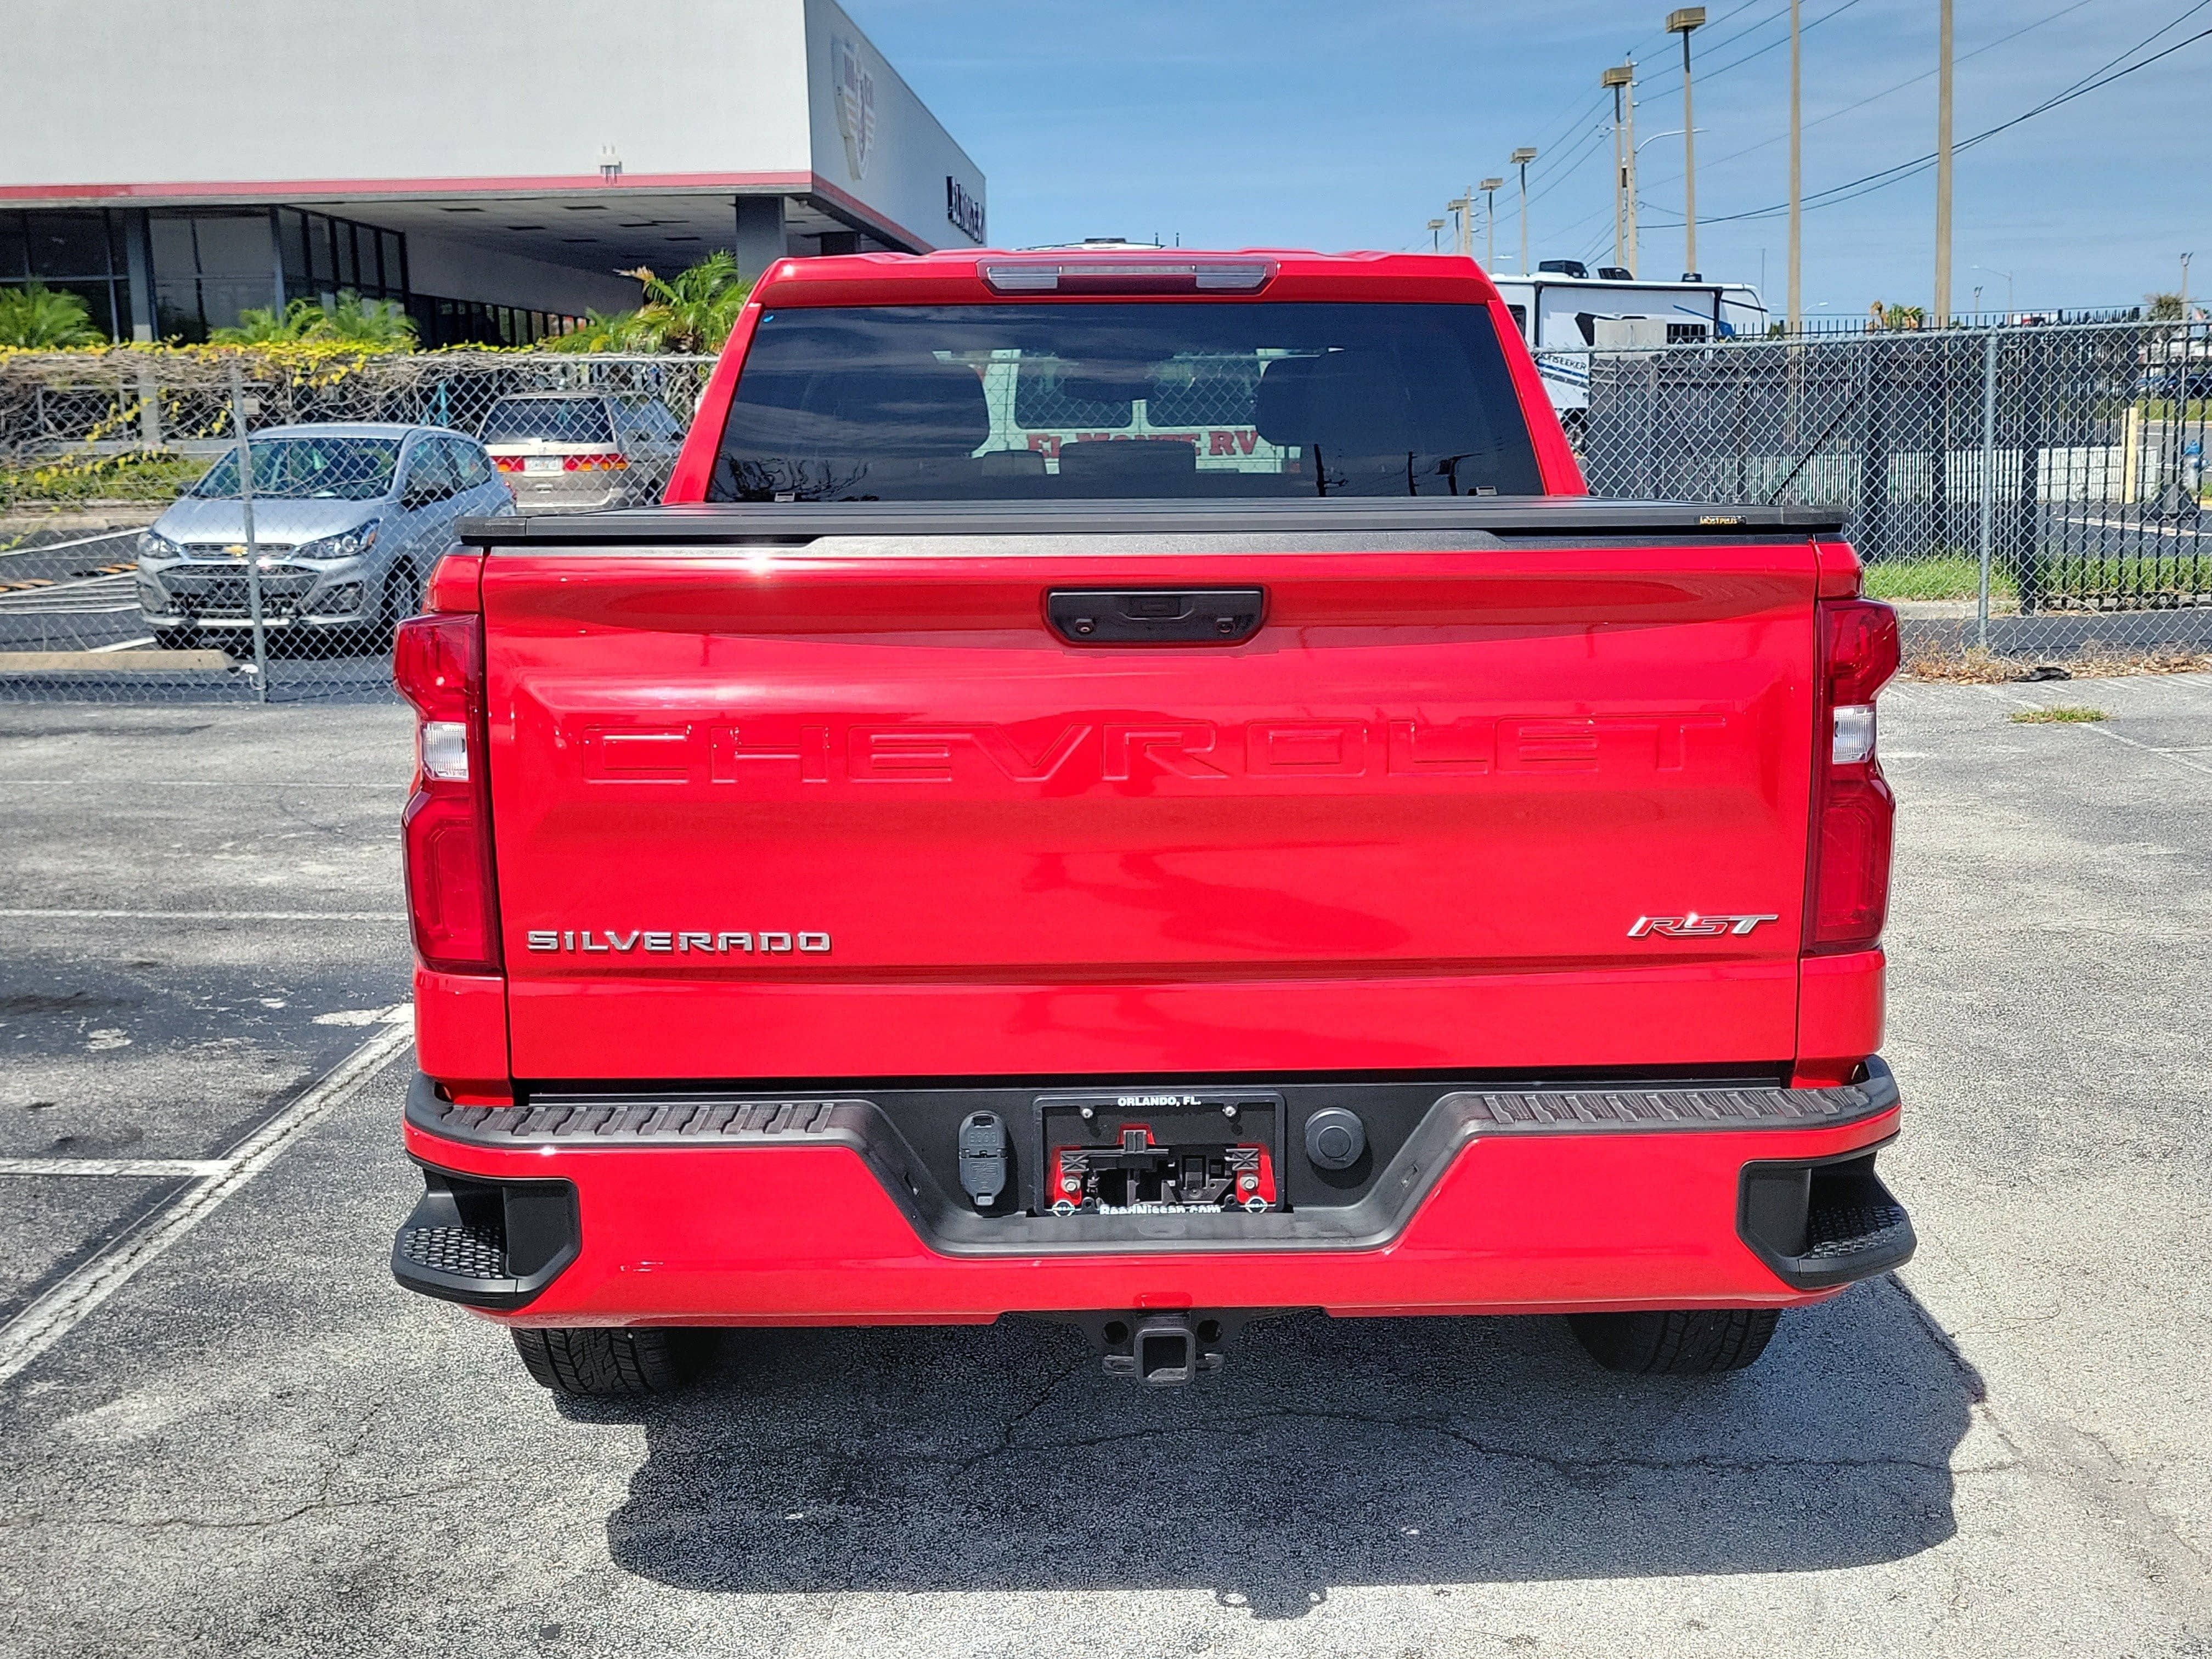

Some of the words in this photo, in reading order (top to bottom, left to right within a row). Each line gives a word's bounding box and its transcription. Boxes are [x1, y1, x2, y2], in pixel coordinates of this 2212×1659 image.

[1209, 430, 1259, 456] RV
[580, 713, 1726, 785] CHEVROLET
[1627, 913, 1779, 937] RST
[527, 929, 832, 952] SILVERADO
[1117, 1096, 1181, 1107] ORLANDO,
[1183, 1096, 1202, 1105] FL.
